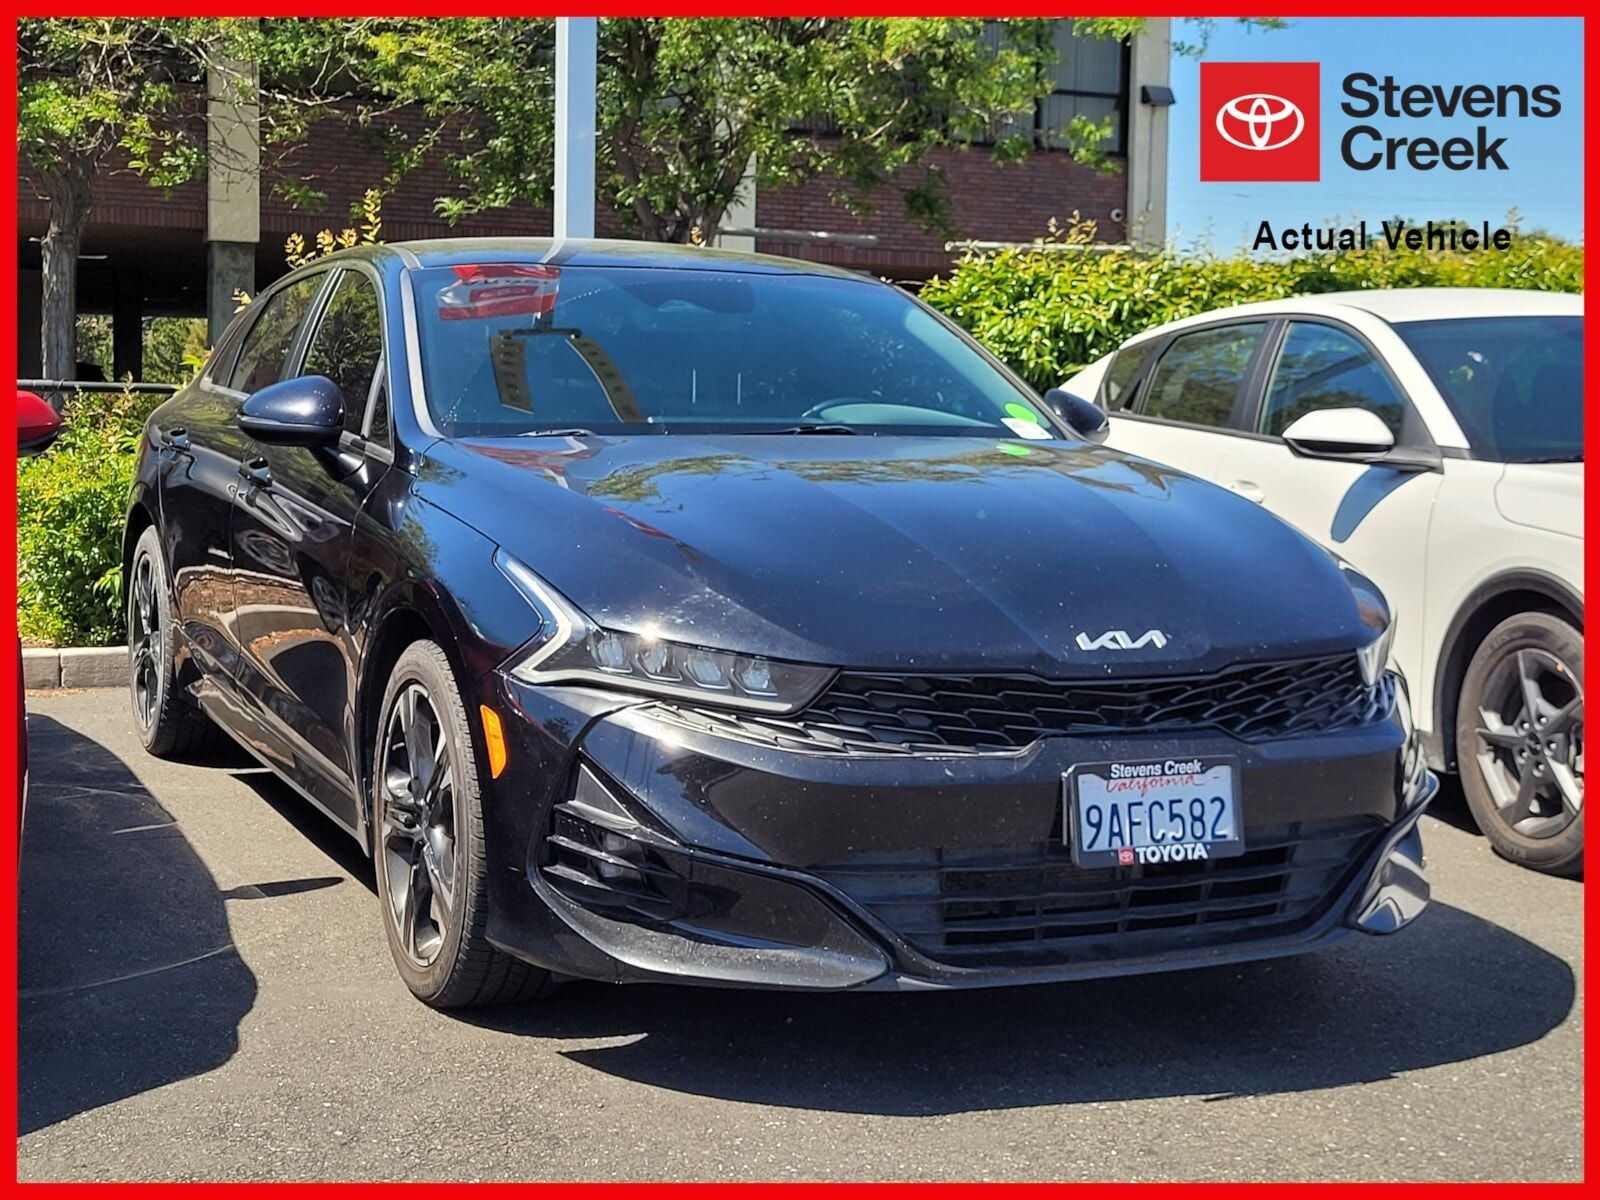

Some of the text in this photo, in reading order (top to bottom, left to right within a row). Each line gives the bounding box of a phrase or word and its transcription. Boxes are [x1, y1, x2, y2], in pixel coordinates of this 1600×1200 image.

[1110, 759, 1202, 778] Stevens Creek
[1086, 796, 1227, 849] 9AFC582
[1135, 842, 1209, 864] TOYOTA
